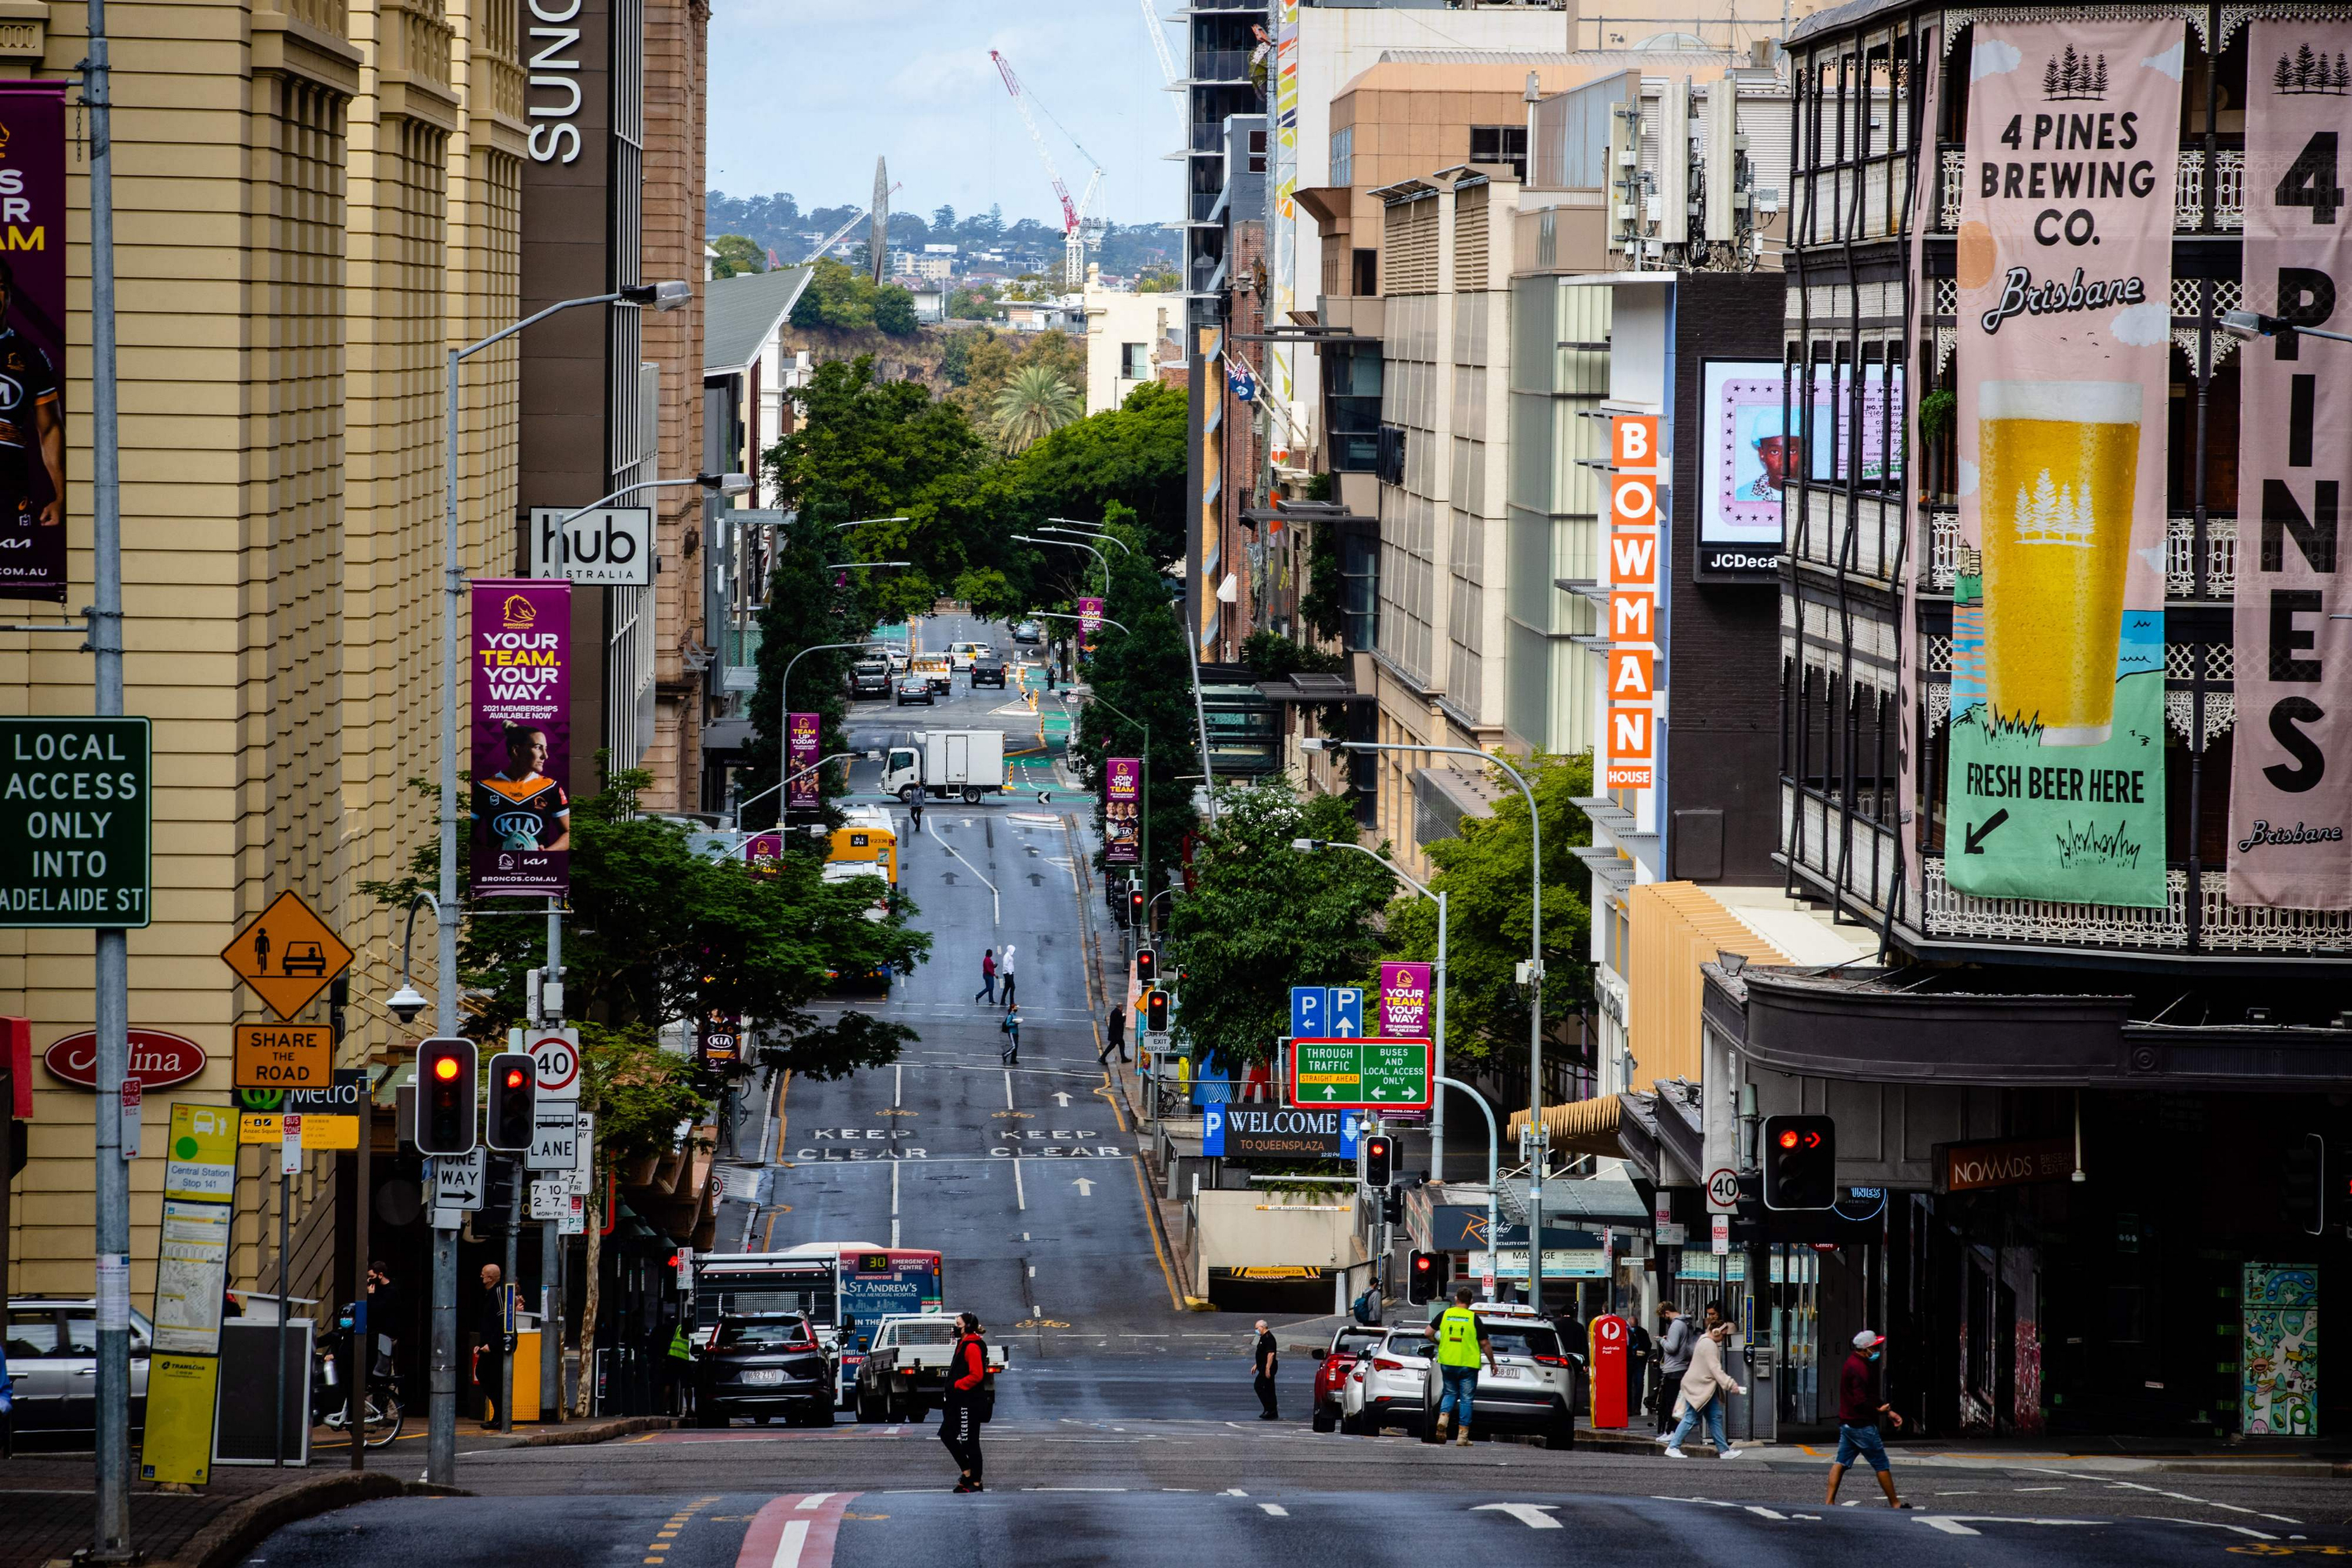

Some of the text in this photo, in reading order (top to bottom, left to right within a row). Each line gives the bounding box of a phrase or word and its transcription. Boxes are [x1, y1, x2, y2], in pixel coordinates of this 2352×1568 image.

[2001, 111, 2138, 150] 4 PINES
[1981, 160, 2155, 199] BREWING
[2274, 132, 2345, 224] 4
[2034, 209, 2100, 246] CO.
[1981, 266, 2145, 336] Brisbane
[543, 514, 636, 564] hub
[543, 570, 634, 579] ASTRALIA
[1613, 423, 1653, 750] BOWMAN
[483, 633, 558, 649] YOUR
[479, 650, 561, 666] TEAM.
[483, 667, 558, 684] YOUR
[488, 684, 552, 701] WAY.
[15, 733, 126, 760] LOCAL
[1609, 771, 1650, 783] HOUSE
[1966, 762, 2144, 804] FRESH BEER HERE
[4, 772, 137, 800] ACCESS
[27, 811, 112, 839] ONLY
[500, 818, 536, 833] KIA
[2238, 819, 2343, 853] Brisbane
[33, 851, 107, 878] INTO
[0, 887, 143, 911] ADELAIDE ST
[1386, 988, 1424, 998] YOUR
[1302, 996, 1317, 1015] P
[1338, 990, 1356, 1012] P
[1385, 997, 1425, 1007] TEAM.
[1385, 1006, 1424, 1015] YOUR
[1388, 1014, 1420, 1024] WAY.
[251, 1033, 317, 1047] SHARE
[712, 1036, 730, 1045] KIA
[273, 1052, 295, 1061] THE
[1306, 1048, 1352, 1058] THROUGH
[538, 1052, 568, 1075] 40
[1308, 1061, 1350, 1071] TRAFFIC
[256, 1065, 310, 1080] ROAD
[125, 1082, 138, 1093] BUS
[1383, 1076, 1405, 1085] ONLY
[122, 1095, 140, 1105] ZONE
[291, 1085, 357, 1104] Metro
[1228, 1111, 1338, 1134] WELCOME
[813, 1129, 911, 1140] KEEP
[1000, 1130, 1096, 1140] KEEP
[531, 1141, 572, 1156] LANE
[990, 1146, 1122, 1157] CLEAR
[1240, 1139, 1324, 1152] TO QUEENSPLAZA
[445, 1153, 477, 1166] ONE
[797, 1148, 927, 1160] CLEAR
[171, 1166, 230, 1178] Central Station
[1955, 1152, 2075, 1184] NOMADS BRISBAN
[183, 1178, 201, 1188] Stop
[441, 1171, 478, 1185] WAY
[1712, 1178, 1737, 1196] 40
[869, 1257, 886, 1268] 30
[866, 1282, 917, 1293] ANDREW'S
